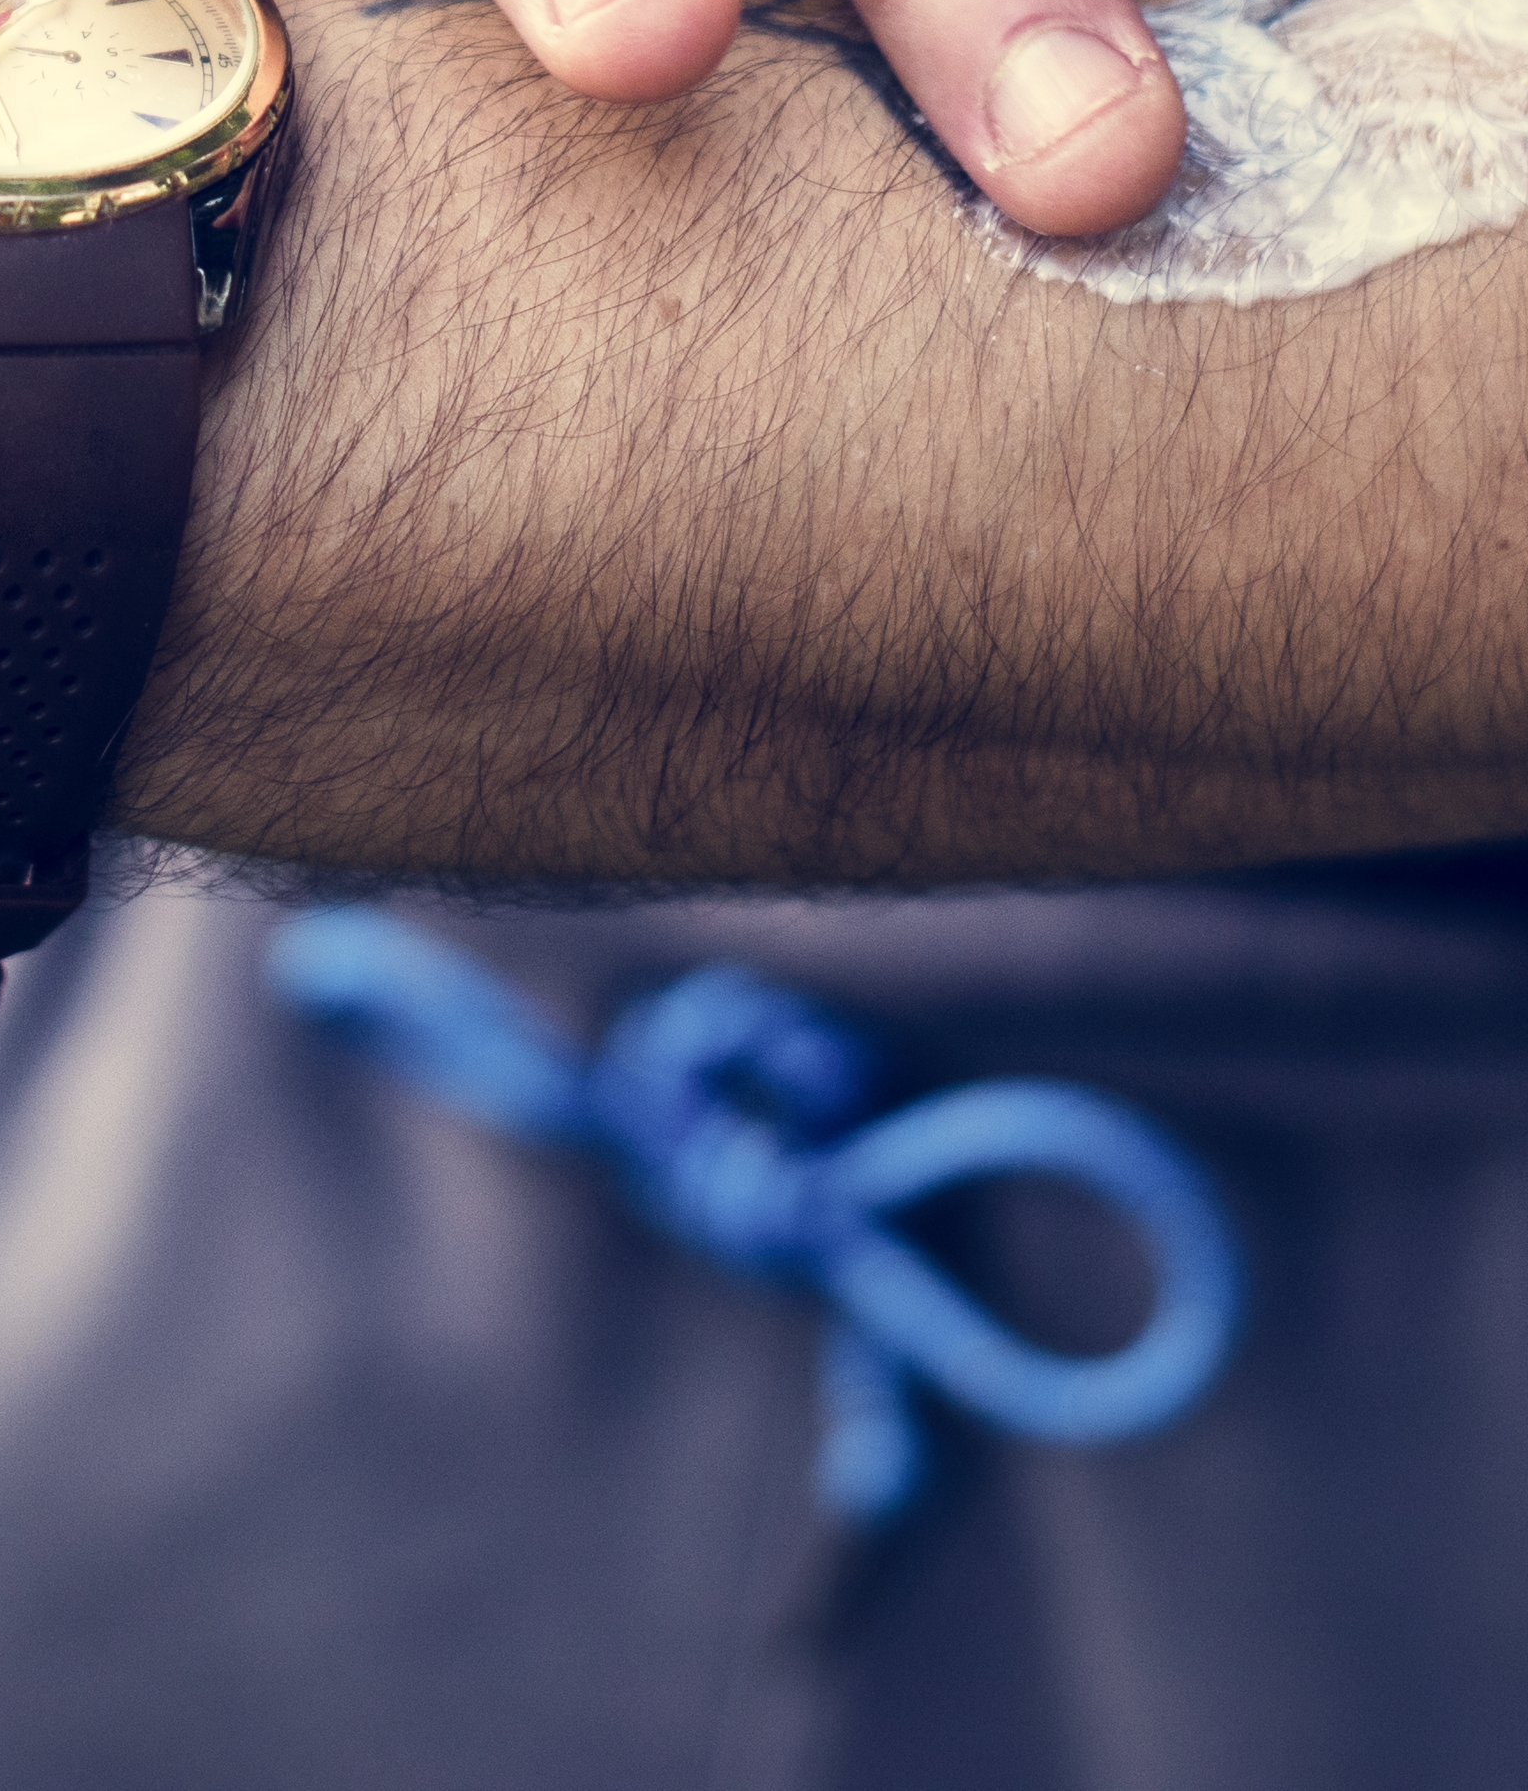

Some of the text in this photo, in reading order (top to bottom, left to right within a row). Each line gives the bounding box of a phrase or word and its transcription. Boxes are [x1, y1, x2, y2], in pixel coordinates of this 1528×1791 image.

[44, 30, 54, 39] 3
[81, 30, 92, 39] 4
[107, 47, 118, 57] 5
[217, 52, 234, 69] 45
[105, 70, 117, 79] 6
[75, 80, 86, 90] 7
